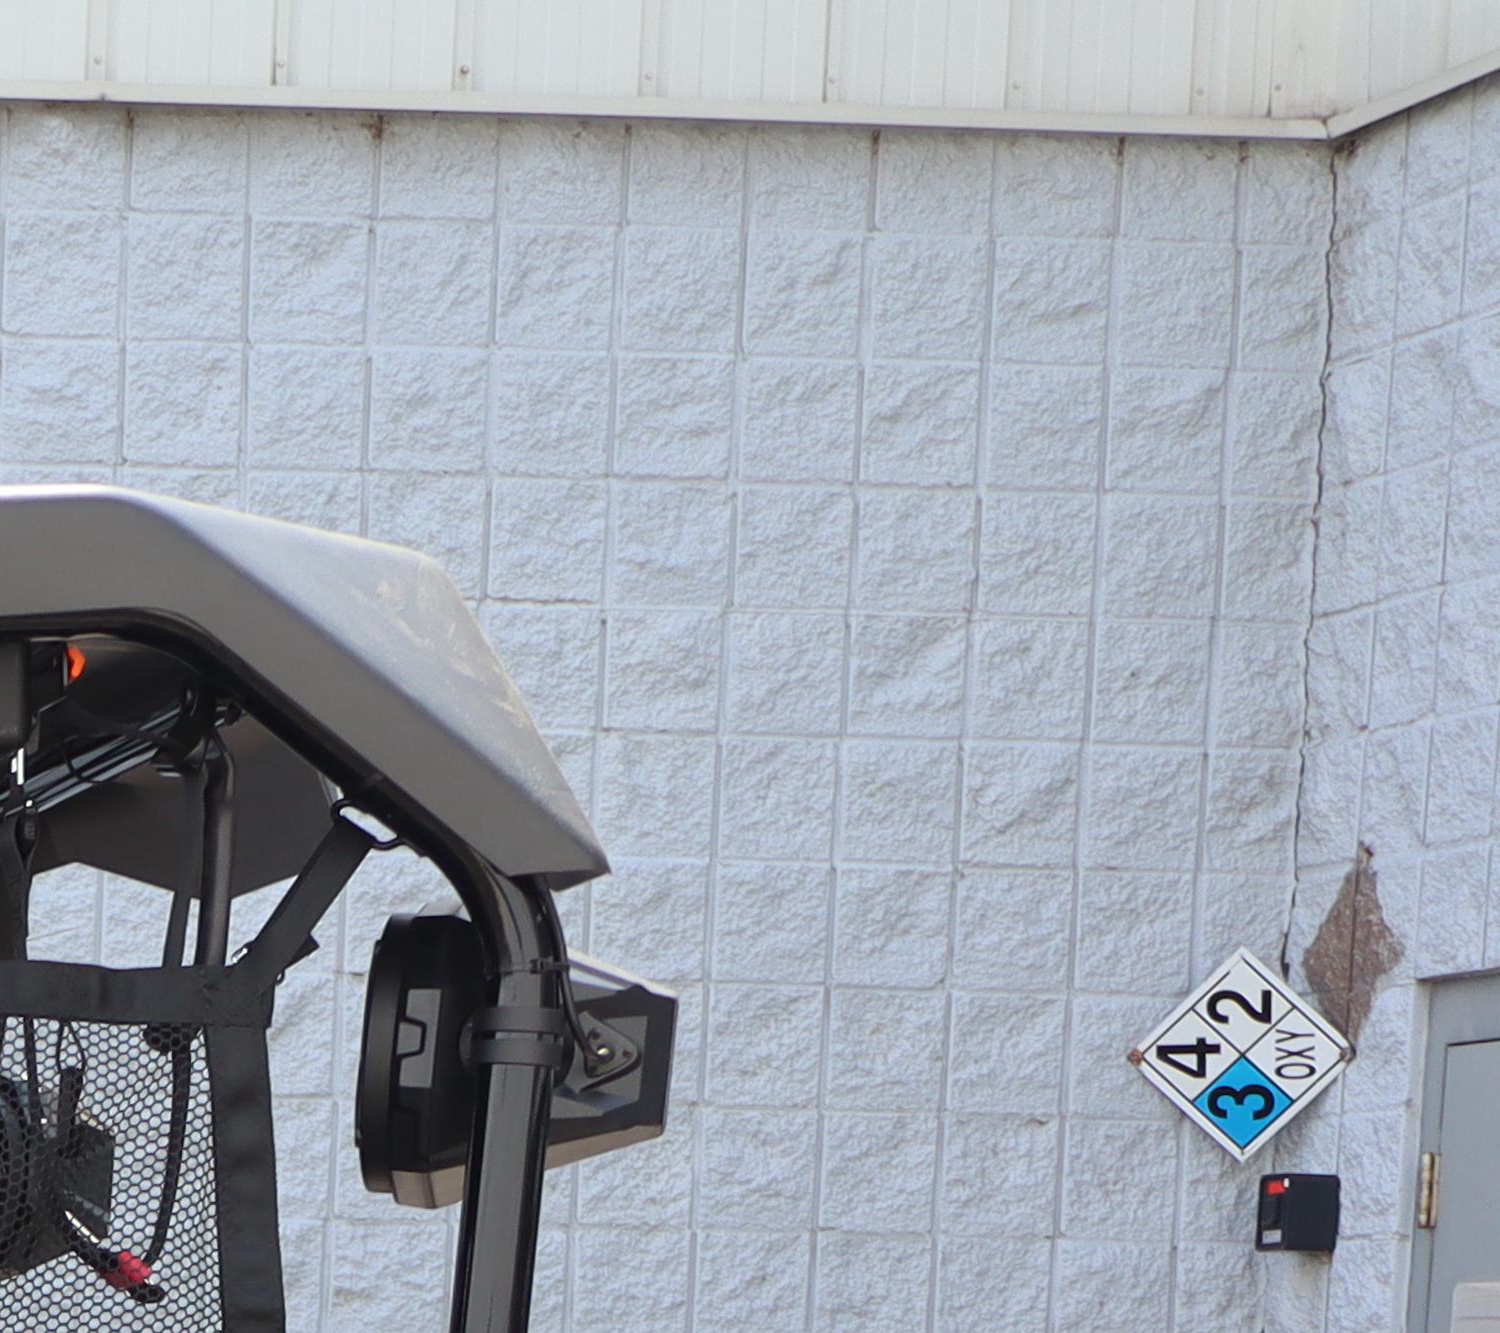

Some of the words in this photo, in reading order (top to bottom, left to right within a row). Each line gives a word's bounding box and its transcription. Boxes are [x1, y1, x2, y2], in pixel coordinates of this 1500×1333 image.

[1207, 989, 1272, 1024] 2
[1156, 1037, 1221, 1079] 4
[1274, 1028, 1316, 1080] OXY
[1207, 1084, 1275, 1120] 3
